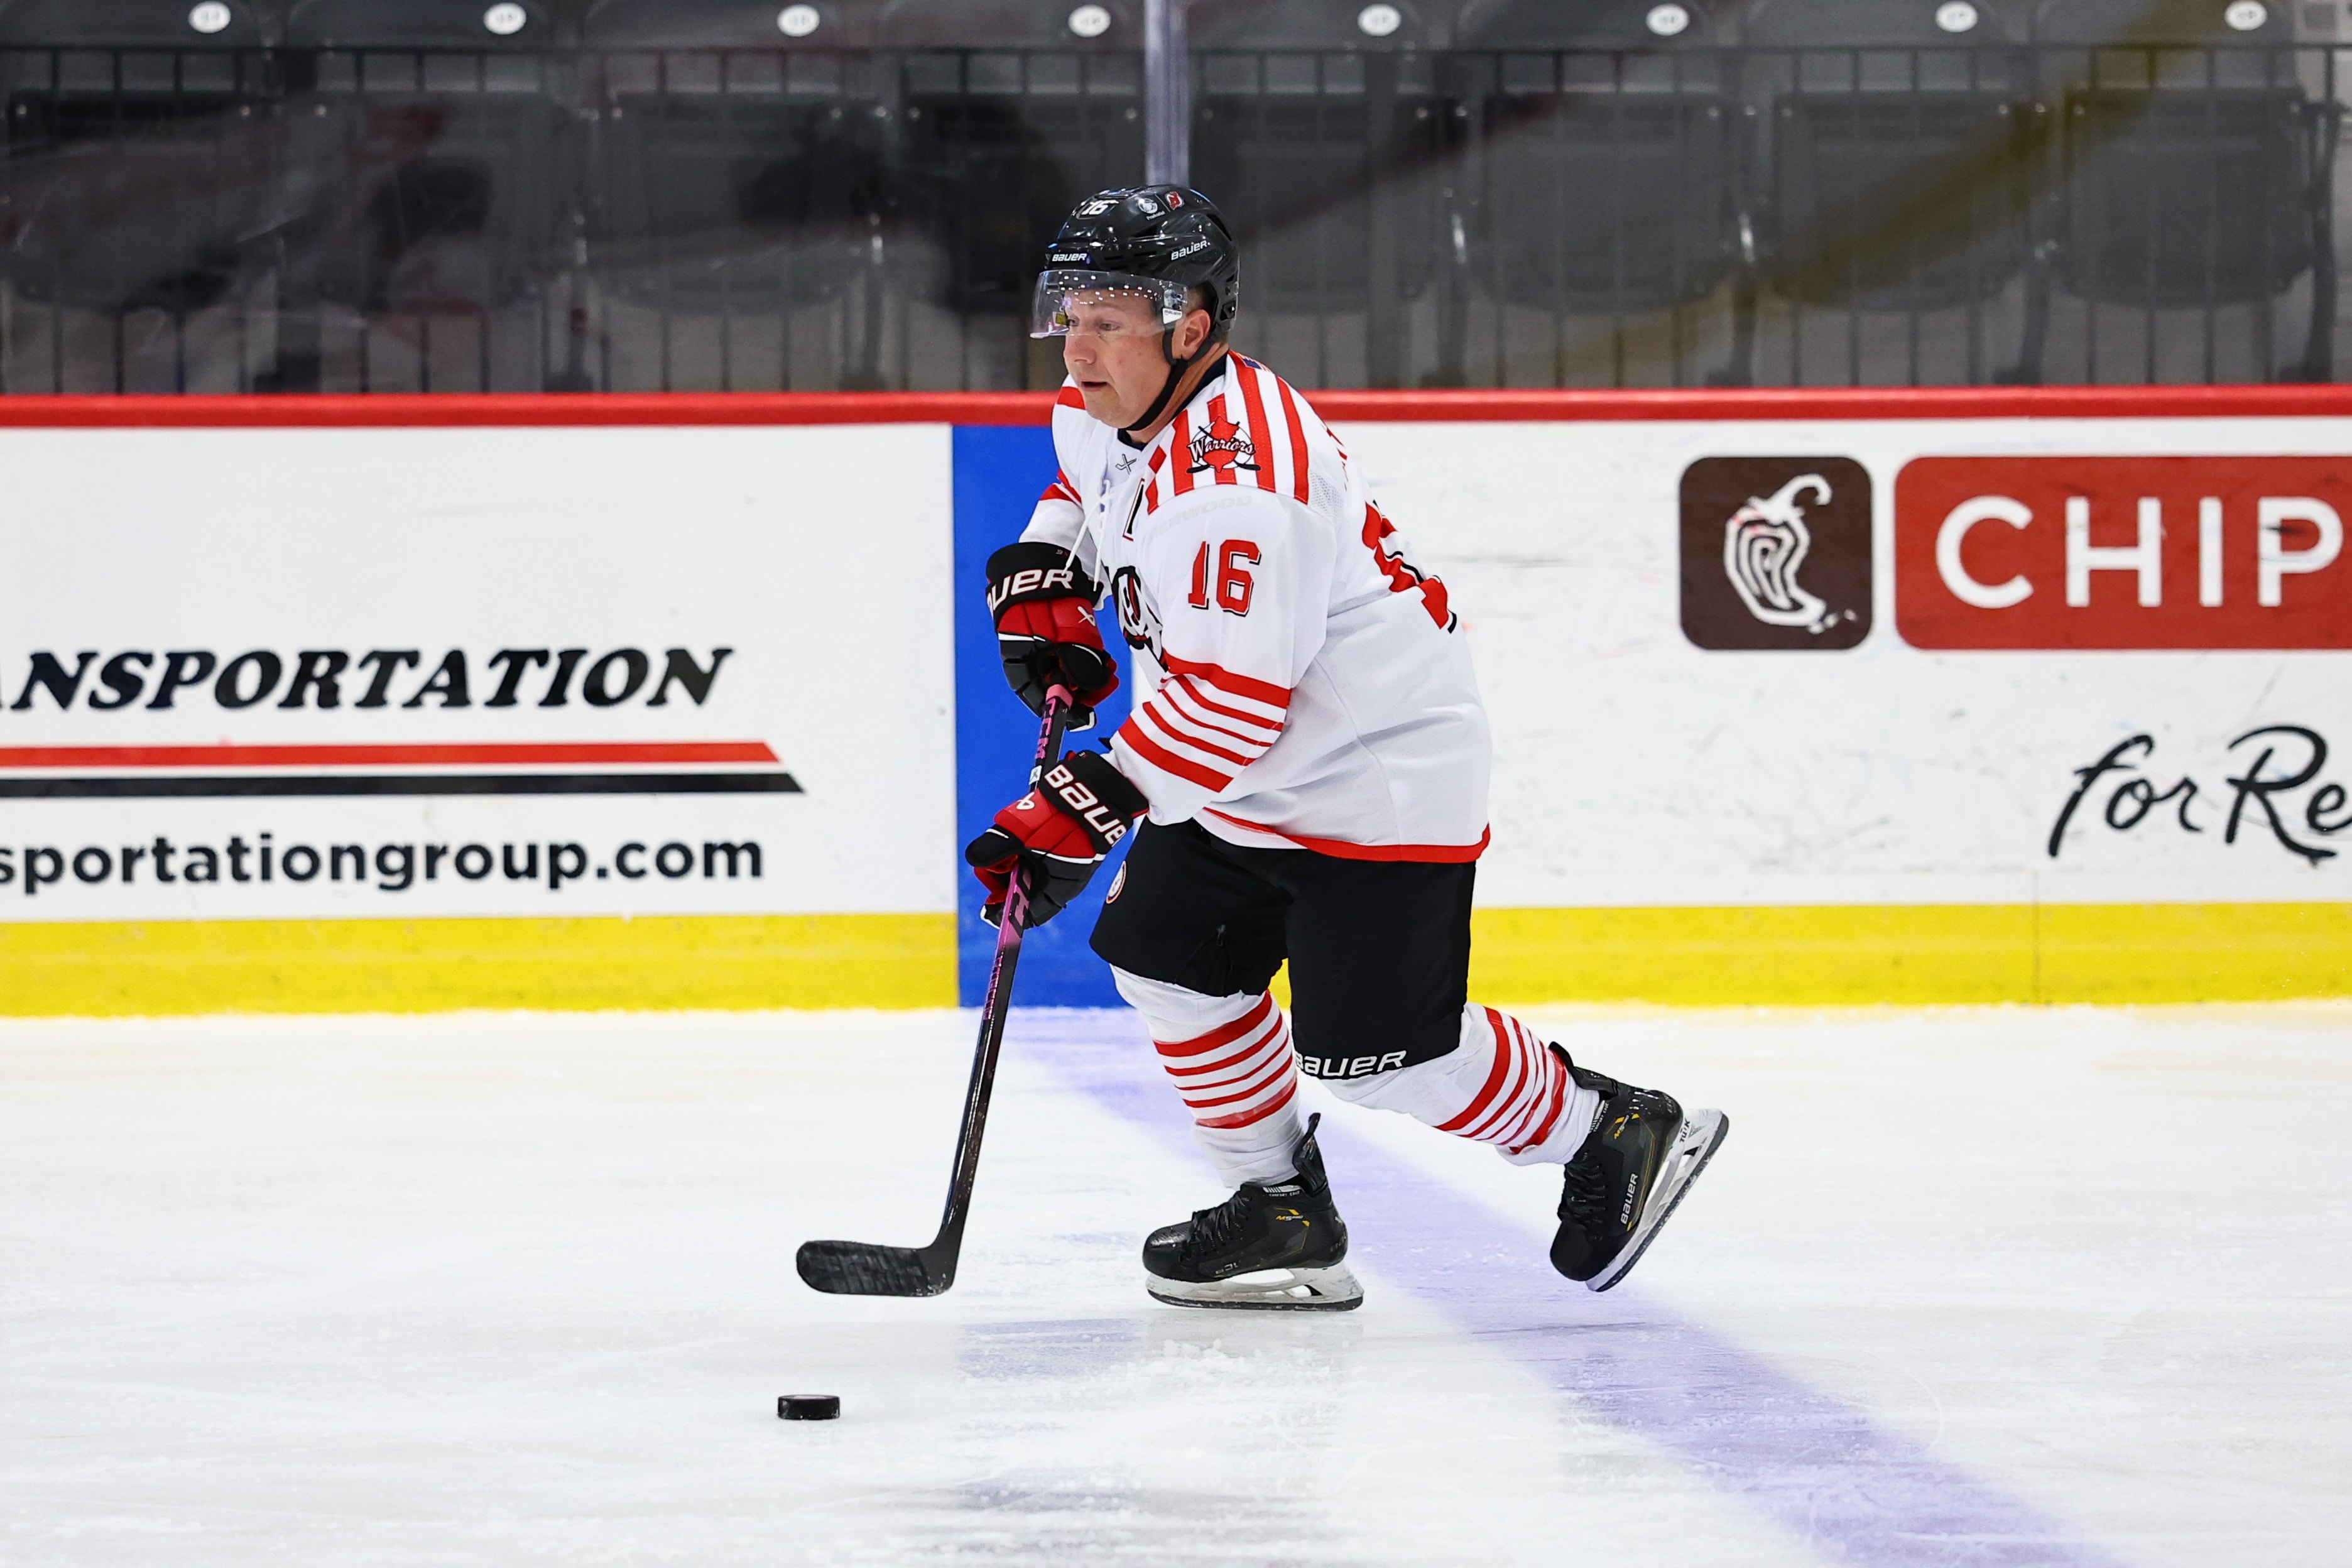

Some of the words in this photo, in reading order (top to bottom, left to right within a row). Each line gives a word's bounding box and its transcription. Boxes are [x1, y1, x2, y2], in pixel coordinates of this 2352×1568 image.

[1186, 435, 1256, 462] Warriors
[1188, 539, 1261, 617] 16
[1936, 496, 2343, 609] CHIP
[987, 569, 1073, 619] UER
[0, 648, 734, 710] NSPORTATION
[1044, 764, 1126, 847] BAUE
[2048, 734, 2202, 858] for
